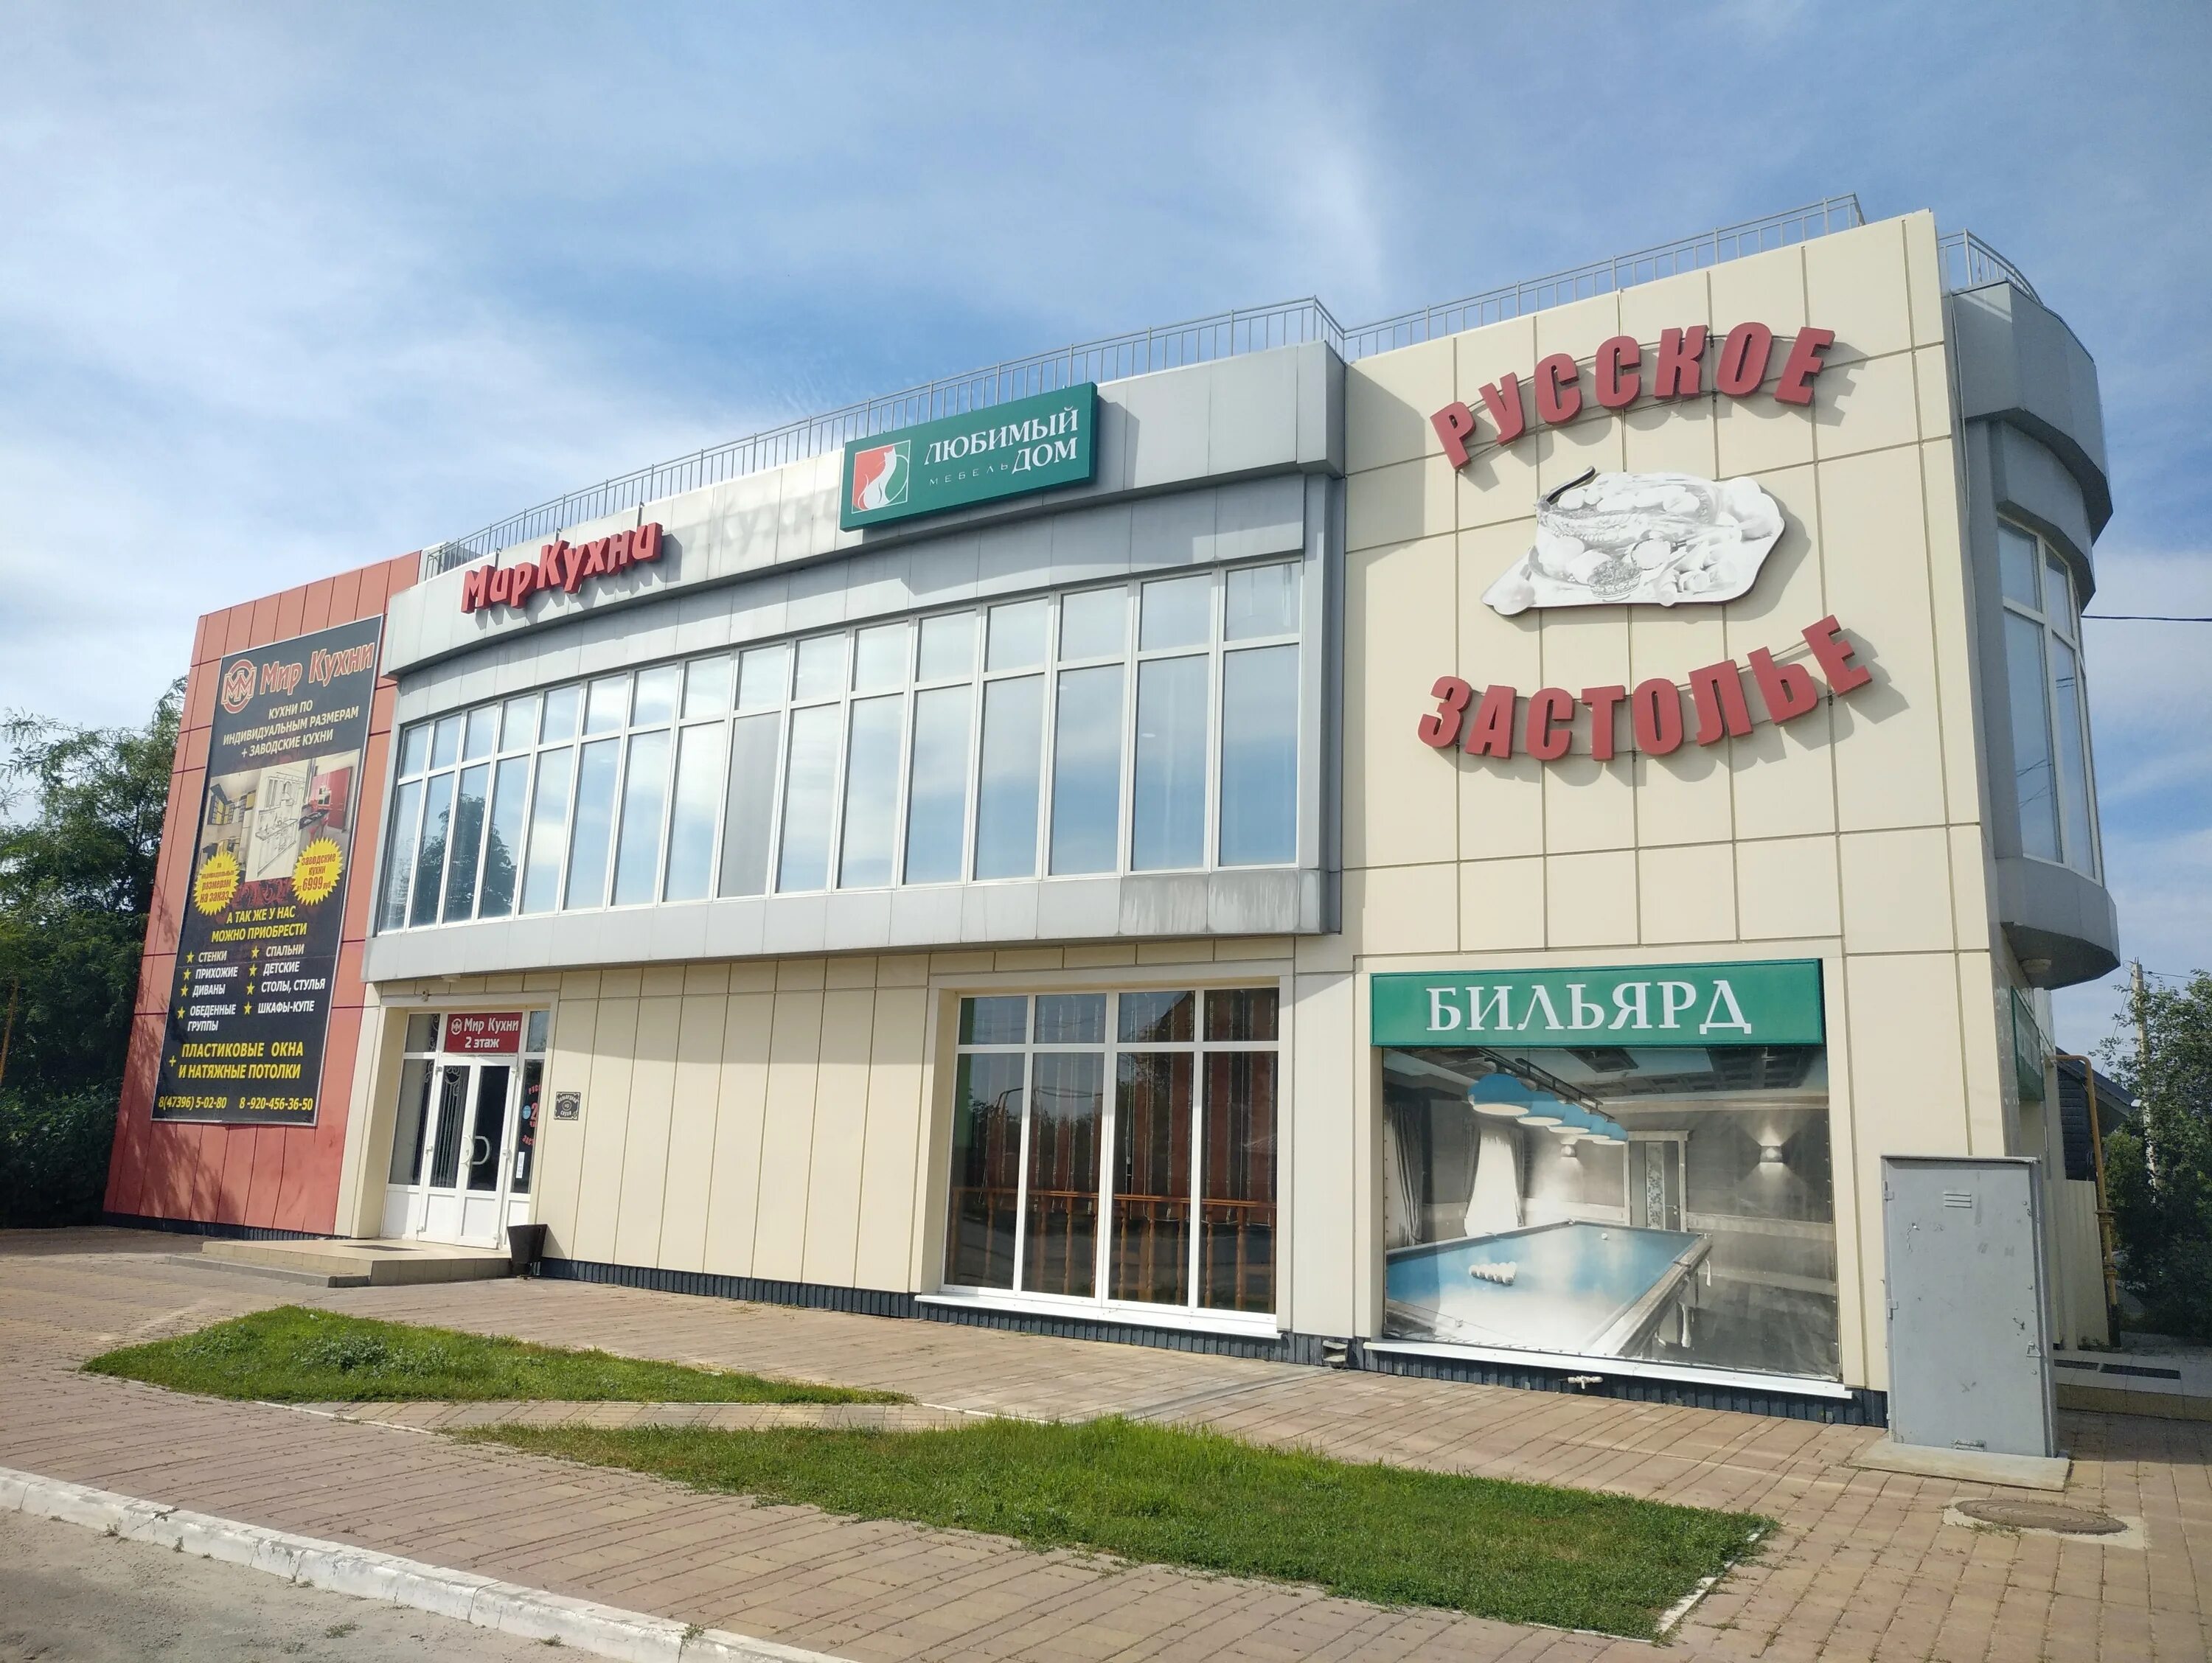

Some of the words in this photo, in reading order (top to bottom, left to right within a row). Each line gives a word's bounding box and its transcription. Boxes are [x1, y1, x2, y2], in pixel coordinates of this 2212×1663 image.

[1430, 321, 1835, 471] РУССКОЕ
[923, 405, 1079, 466] ЛЮБИМЫЙ
[1012, 437, 1077, 474] ДОМ
[930, 463, 1008, 487] МЕБЕЛЬ
[260, 661, 303, 695] Мир
[308, 642, 375, 687] Кухни
[1418, 615, 1873, 761] ЗАСТОЛЬЕ
[268, 702, 298, 720] КУХНИ
[299, 700, 313, 713] ПО
[223, 717, 308, 746] ИНДИВИДУАЛЬНЫМ
[310, 705, 359, 726] РАЗМЕРАМ
[248, 734, 301, 758] ЗАВОДСКИЕ
[302, 729, 333, 746] КУХНИ
[302, 876, 323, 891] 6999
[226, 913, 234, 924] А
[234, 910, 252, 923] ТАК
[253, 908, 267, 921] ЖЕ
[268, 907, 276, 921] У
[276, 905, 296, 919] НАС
[211, 927, 246, 943] МОЖНО
[247, 923, 307, 940] ПРИОБРЕСТИ
[198, 951, 227, 963] СТЕНКИ
[265, 944, 305, 957] СПАЛЬНИ
[195, 966, 238, 980] ПРИХОЖИЕ
[262, 961, 300, 976] ДЕТСКИЕ
[192, 984, 226, 997] ДИВАНЫ
[261, 980, 291, 994] СТОЛЫ,
[293, 978, 326, 991] СТУЛЬЯ
[189, 1004, 236, 1017] ОБЕДЕННЫЕ
[257, 1000, 315, 1014] ШКАФЫ-КУПЕ
[1426, 980, 1752, 1035] БИЛЬЯРД
[187, 1020, 219, 1032] ГРУППЫ
[464, 1017, 484, 1035] Мир
[487, 1017, 519, 1034] Кухни
[181, 1042, 265, 1058] ПЛАСТИКОВЫЕ
[271, 1042, 304, 1057] ОКНА
[465, 1036, 472, 1048] 2
[473, 1038, 500, 1048] этаж
[178, 1064, 187, 1078] И
[188, 1064, 246, 1079] НАТЯЖНЫЕ
[248, 1064, 301, 1079] ПОТОЛКИ
[195, 1097, 227, 1109] 5-02-80
